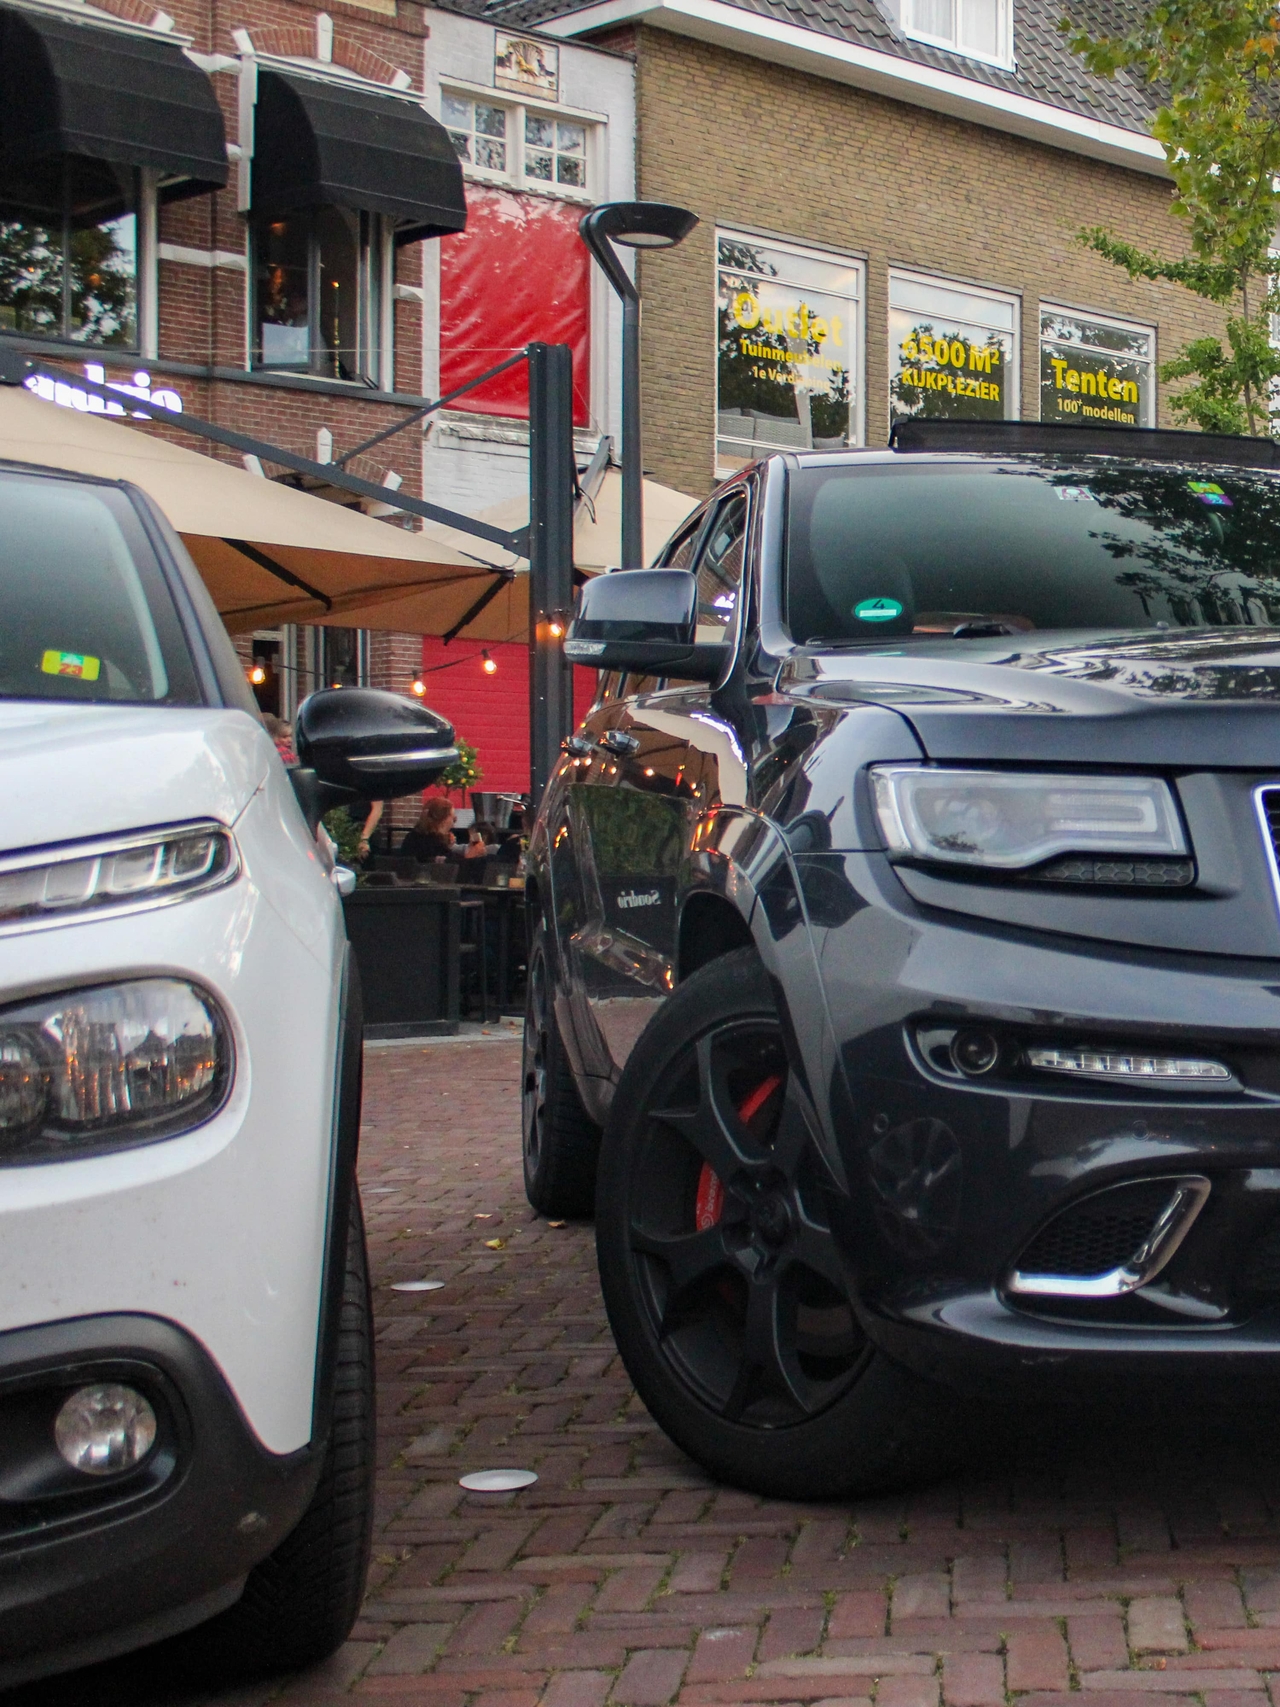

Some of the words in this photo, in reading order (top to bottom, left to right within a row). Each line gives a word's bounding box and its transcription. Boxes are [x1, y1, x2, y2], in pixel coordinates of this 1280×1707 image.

[733, 292, 844, 347] Outlet
[902, 332, 966, 366] 6500
[752, 366, 767, 379] 1e
[902, 368, 1000, 402] KIJKPLEZIER
[1050, 358, 1139, 404] Tenten
[1082, 404, 1135, 424] modellen
